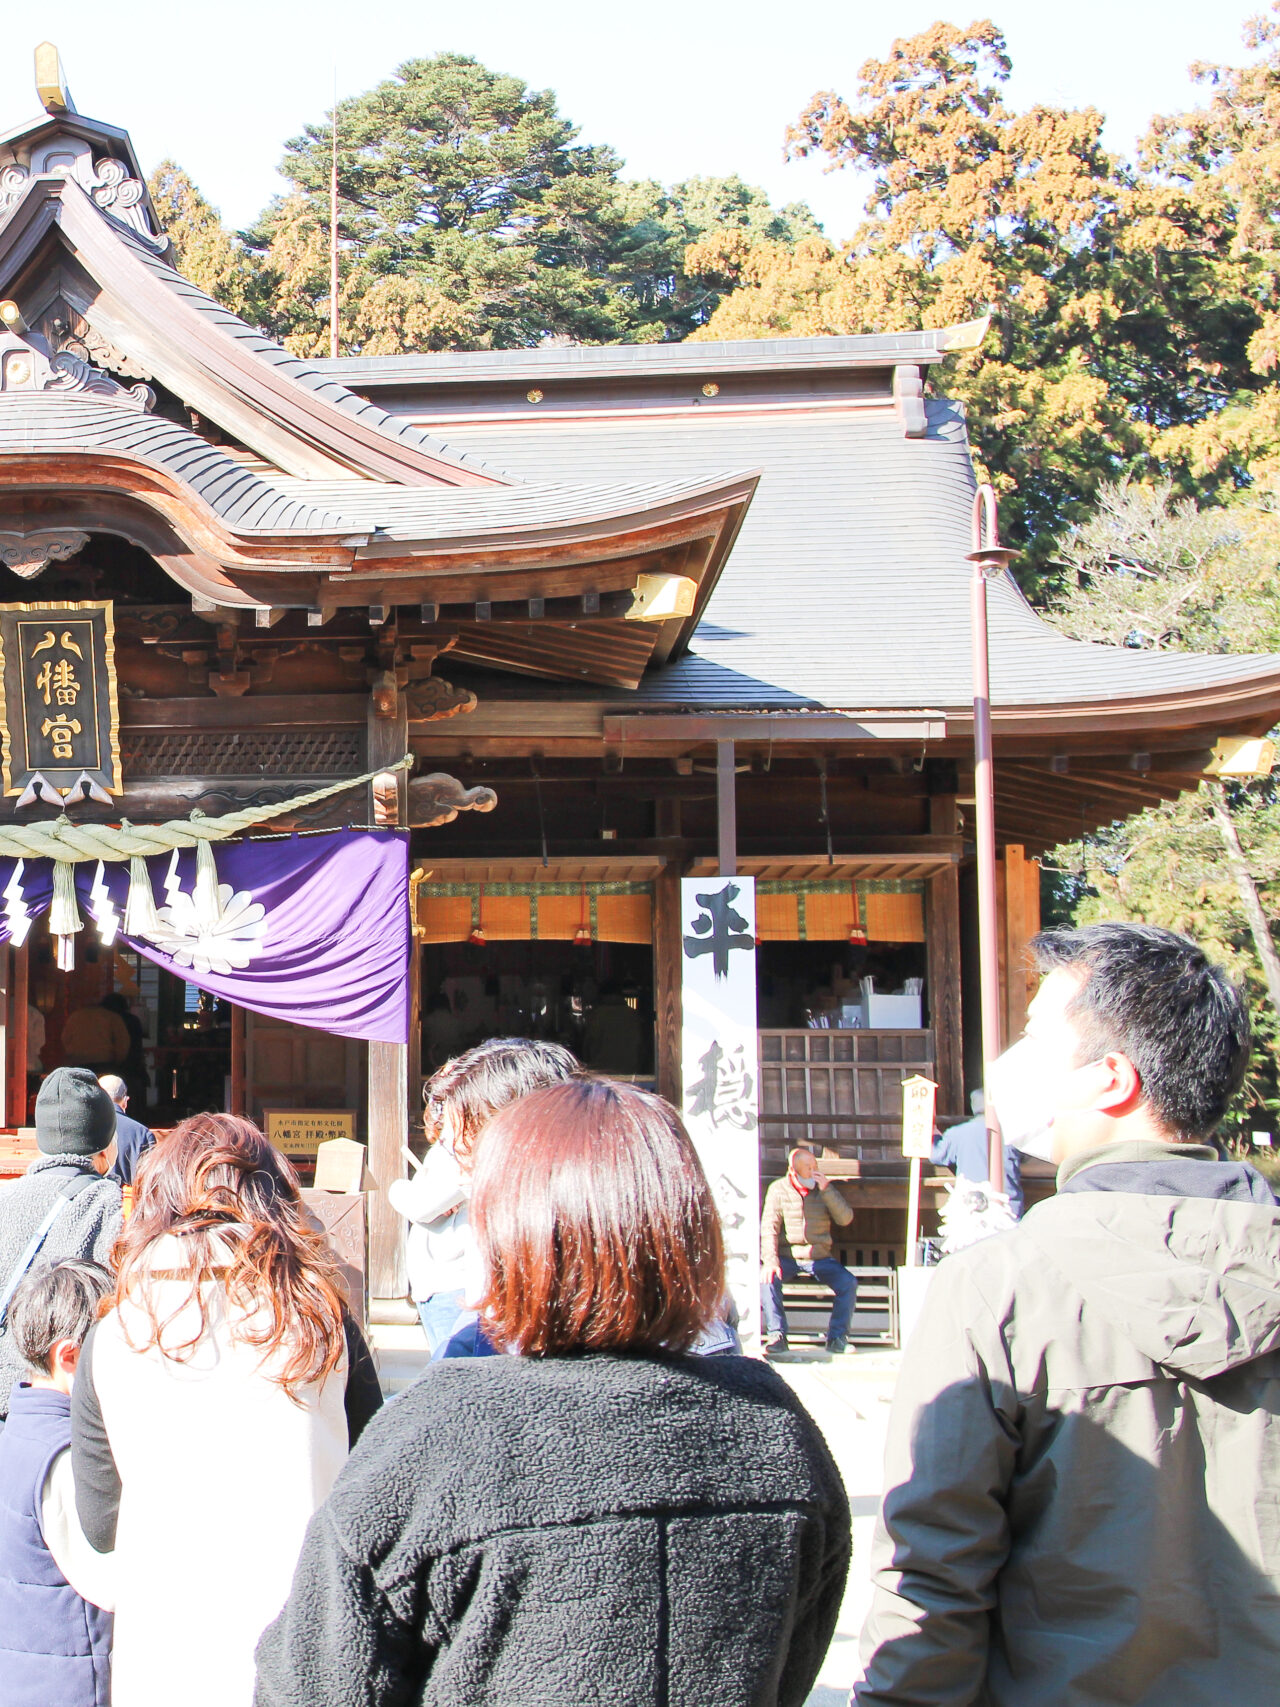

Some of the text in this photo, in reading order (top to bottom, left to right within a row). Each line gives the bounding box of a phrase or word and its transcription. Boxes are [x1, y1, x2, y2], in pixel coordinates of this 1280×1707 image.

[30, 630, 84, 759] 八幡宮
[683, 881, 758, 1132] 平穏
[273, 1129, 302, 1139] 八幡宮
